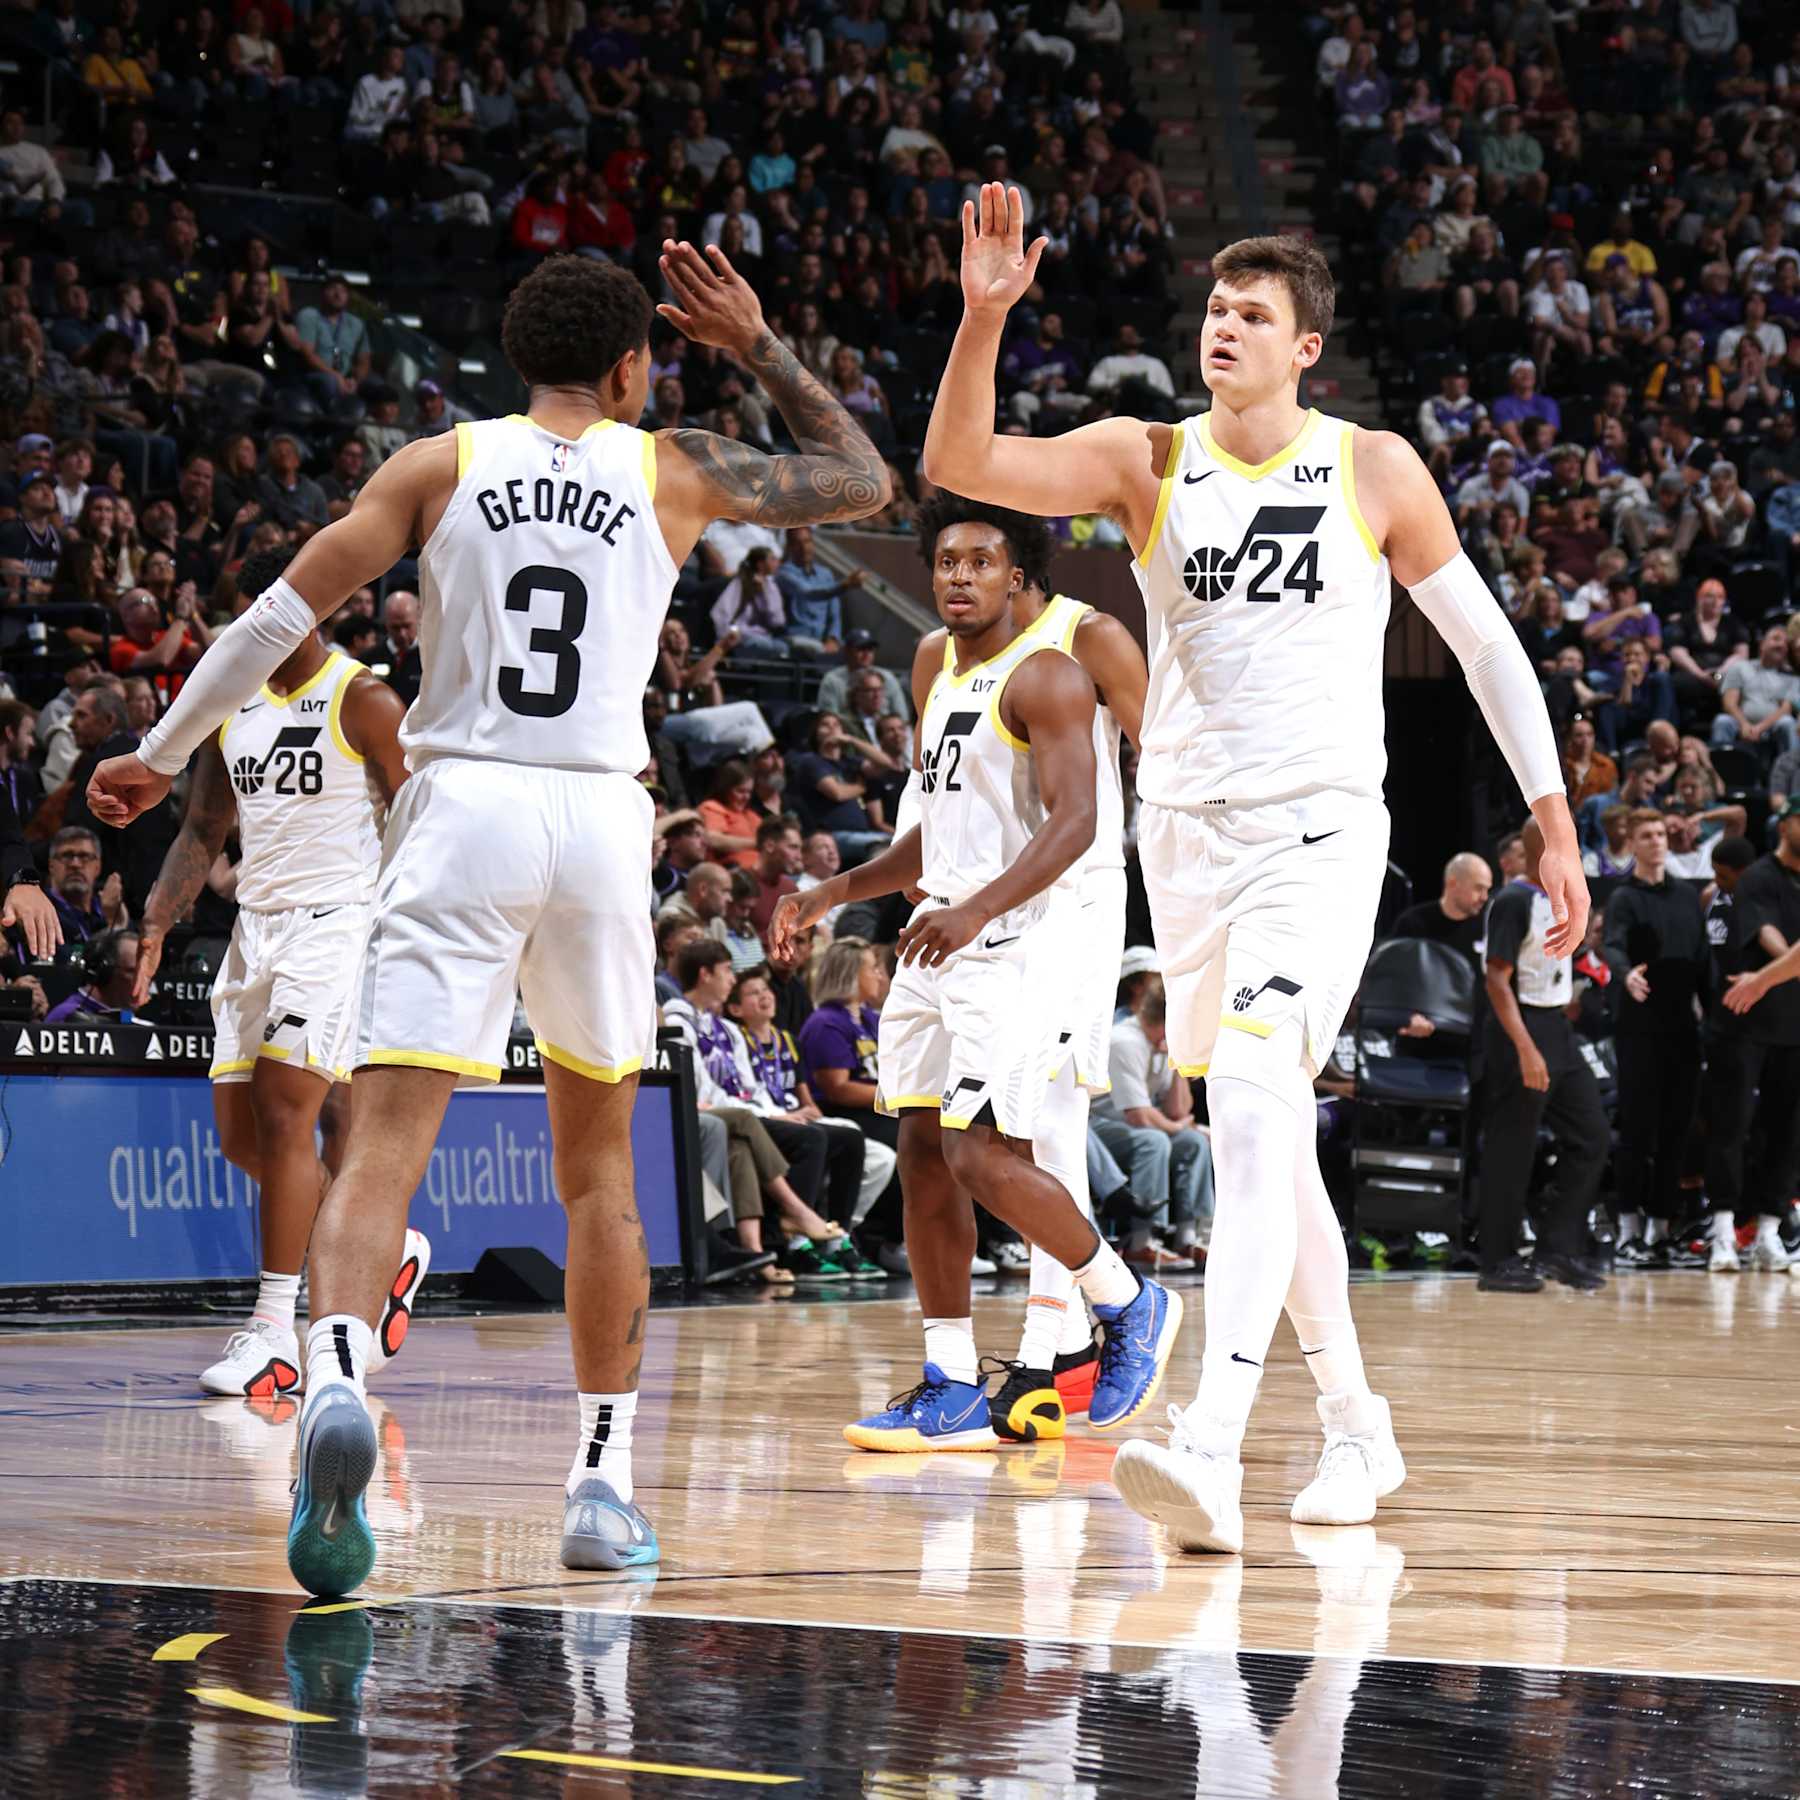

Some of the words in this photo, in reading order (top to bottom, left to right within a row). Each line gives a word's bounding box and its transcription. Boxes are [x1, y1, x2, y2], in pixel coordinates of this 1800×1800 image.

[1294, 464, 1333, 483] LVT
[476, 478, 636, 547] GEORGE
[1246, 539, 1324, 604] 24
[498, 564, 588, 718] 3
[971, 678, 997, 693] LVT
[301, 699, 327, 713] LVT
[274, 750, 323, 796] 28
[946, 739, 961, 791] 2
[40, 1029, 114, 1055] DELTA
[169, 1034, 214, 1059] DEL
